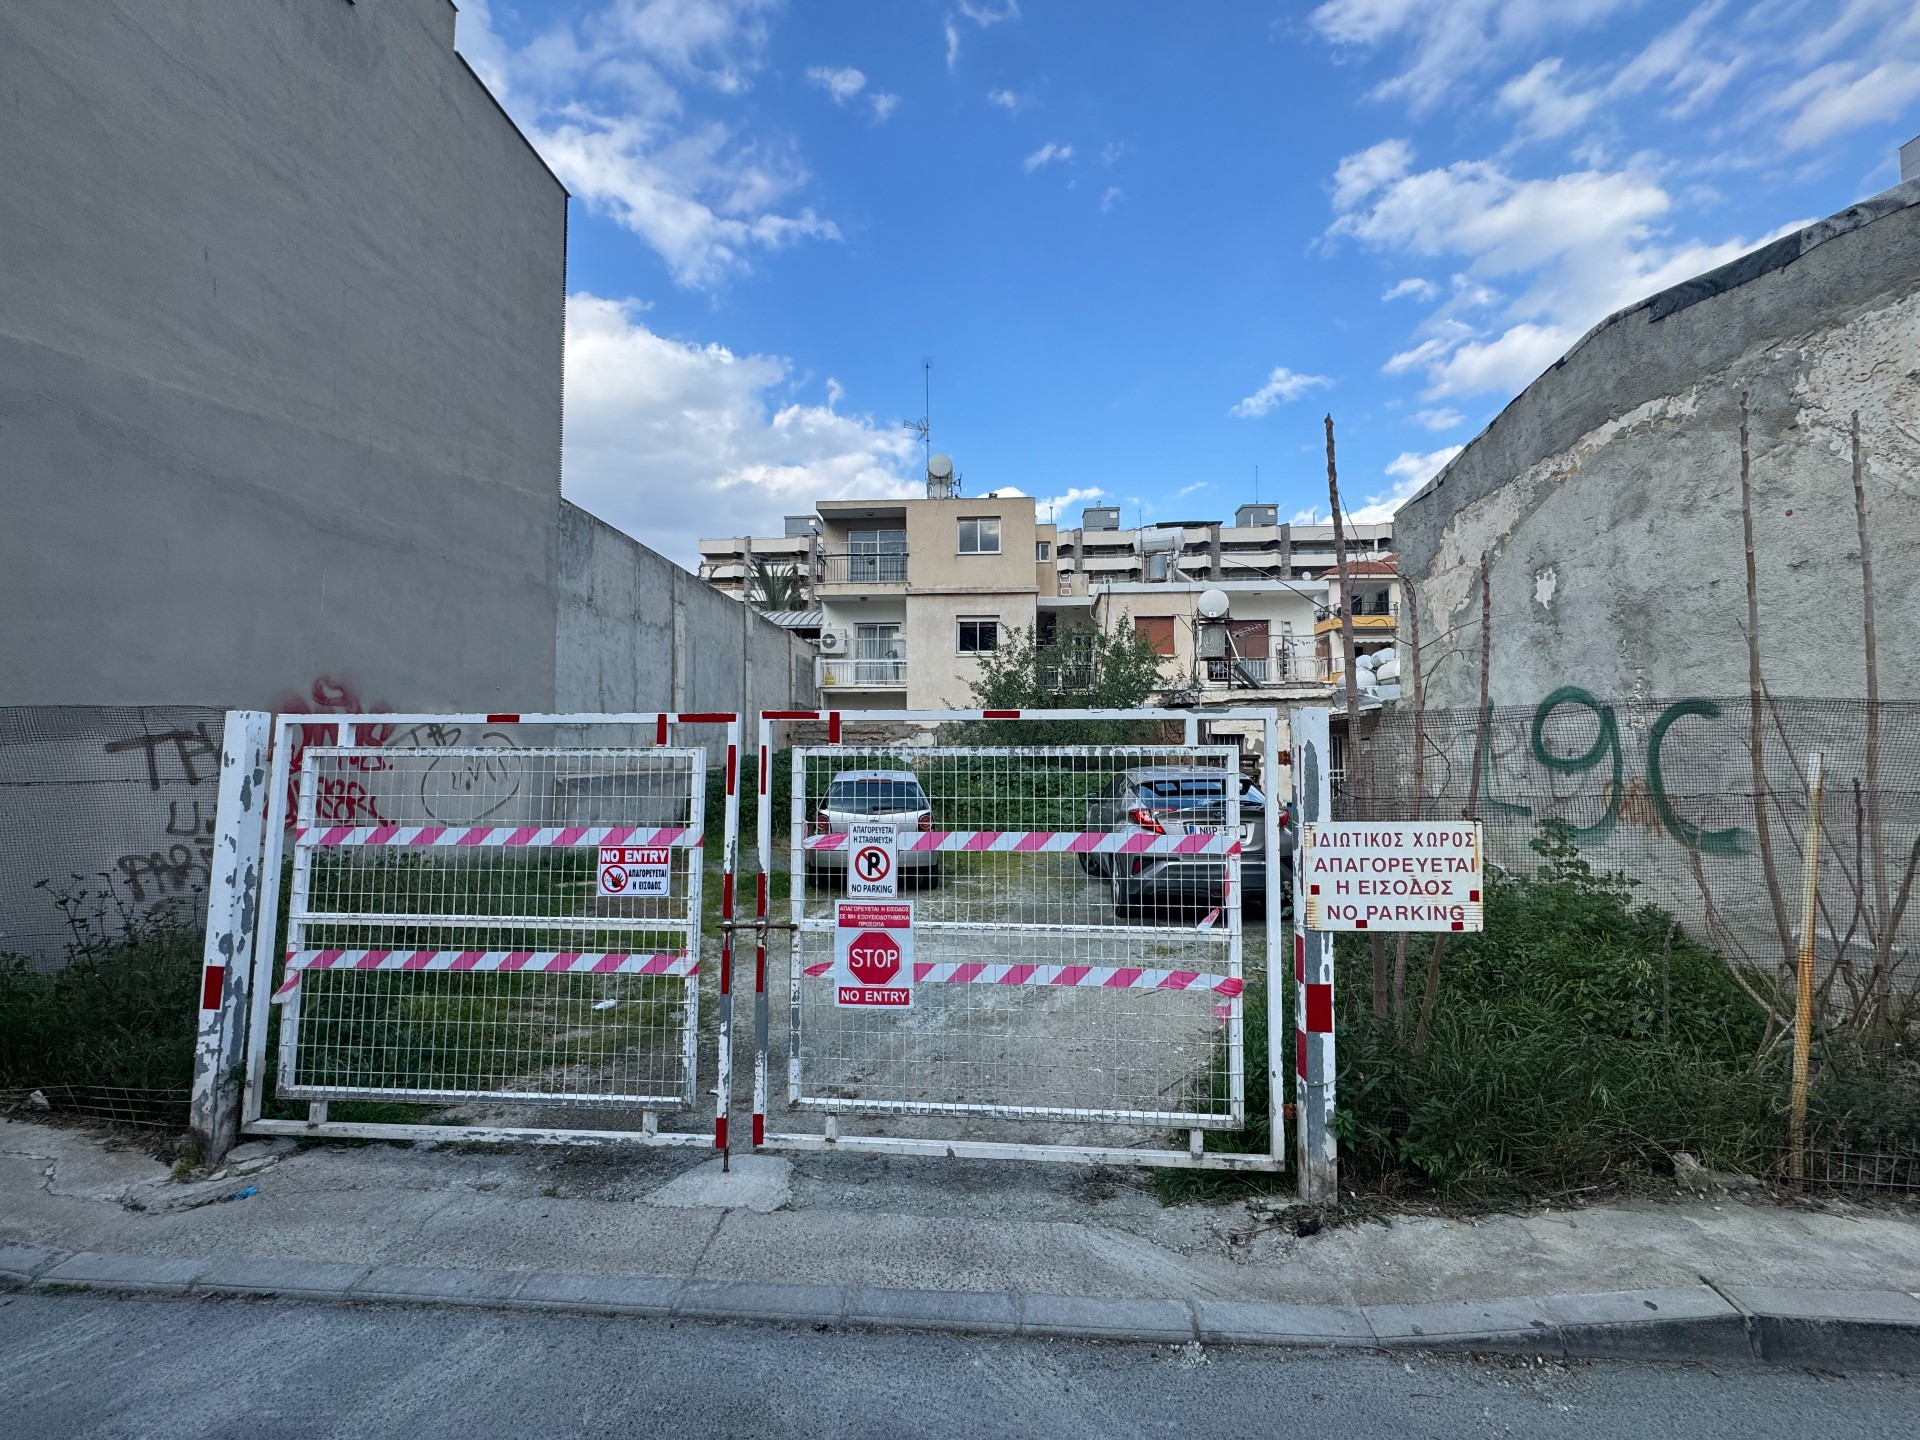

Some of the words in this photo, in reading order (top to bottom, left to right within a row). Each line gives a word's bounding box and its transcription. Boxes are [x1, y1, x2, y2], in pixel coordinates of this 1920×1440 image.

[853, 826, 894, 834] ΑΠΑΓΟΡΕΥΕΤΑΙ
[859, 836, 893, 844] ΣΤΑΘΜΕΥΣΗ
[1312, 832, 1404, 848] ΙΔΙΩΤΙΚΟΣ
[1413, 832, 1475, 848] ΧΩΡΟΣ
[601, 850, 620, 862] NO
[625, 850, 668, 862] ENTRY
[1314, 857, 1475, 873] ΑΠΑΓΟΡΕΥΕΤΑΙ
[628, 869, 667, 878] ΑΠΑΓΟΡΕΥΕΤΑΙ
[632, 881, 637, 890] Η
[638, 881, 661, 890] ΕΙΣΟΔΟΣ
[851, 884, 862, 892] NO
[863, 884, 892, 894] PARKING
[1336, 880, 1349, 895] Η
[1358, 880, 1453, 896] ΕΙΣΟΔΟΣ
[1327, 905, 1358, 921] NO
[1366, 905, 1464, 921] PARKING
[851, 948, 898, 968] STOP
[841, 990, 859, 1001] NO
[865, 990, 907, 1002] ENTRY
